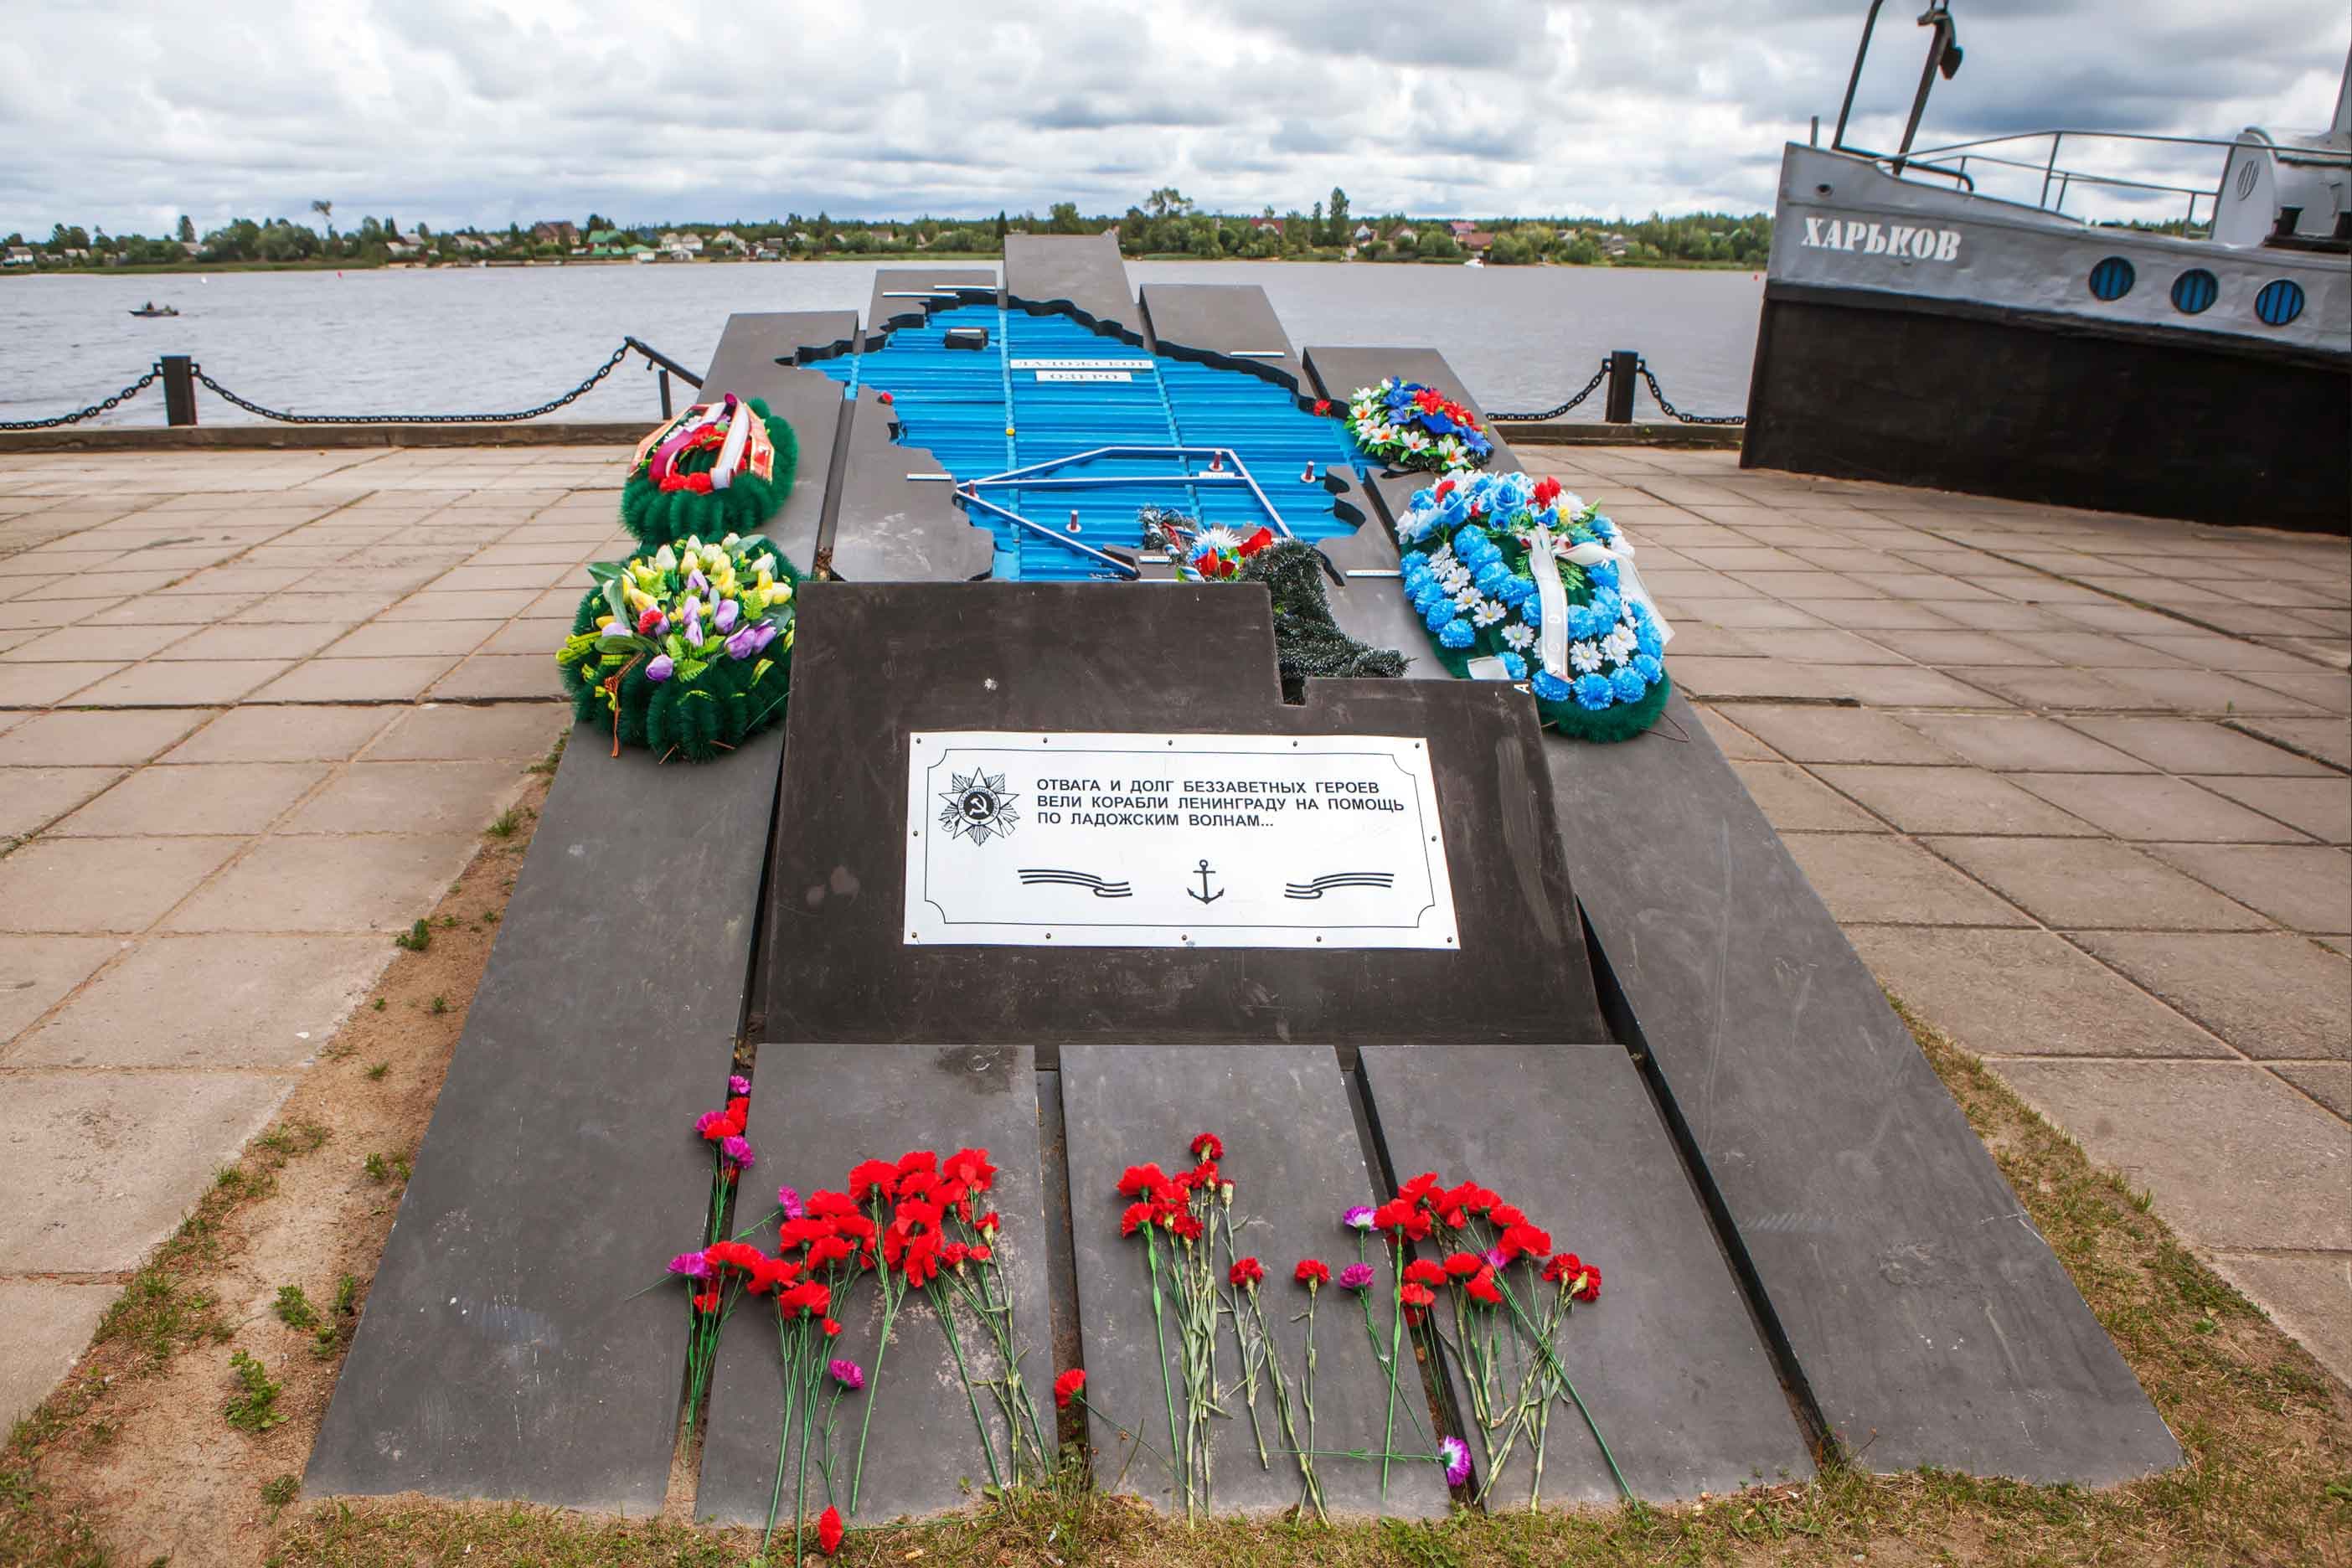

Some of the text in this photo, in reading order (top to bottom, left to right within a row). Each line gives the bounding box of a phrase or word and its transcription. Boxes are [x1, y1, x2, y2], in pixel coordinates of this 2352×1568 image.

[1801, 217, 1962, 262] ХАРЬКОВ
[1037, 779, 1380, 794] ОТВАГА И ДОЛГ БЕЗЗАВЕТНЫХ ГЕРОЕВ
[1037, 795, 1405, 813] ВЕЛИ КОРАБЛИ ЛЕНИНГРАДУ НА ПОМОЩЬ
[1037, 812, 1273, 828] ПО ЛАДОЖСКИМ ВОЛНАМ...
